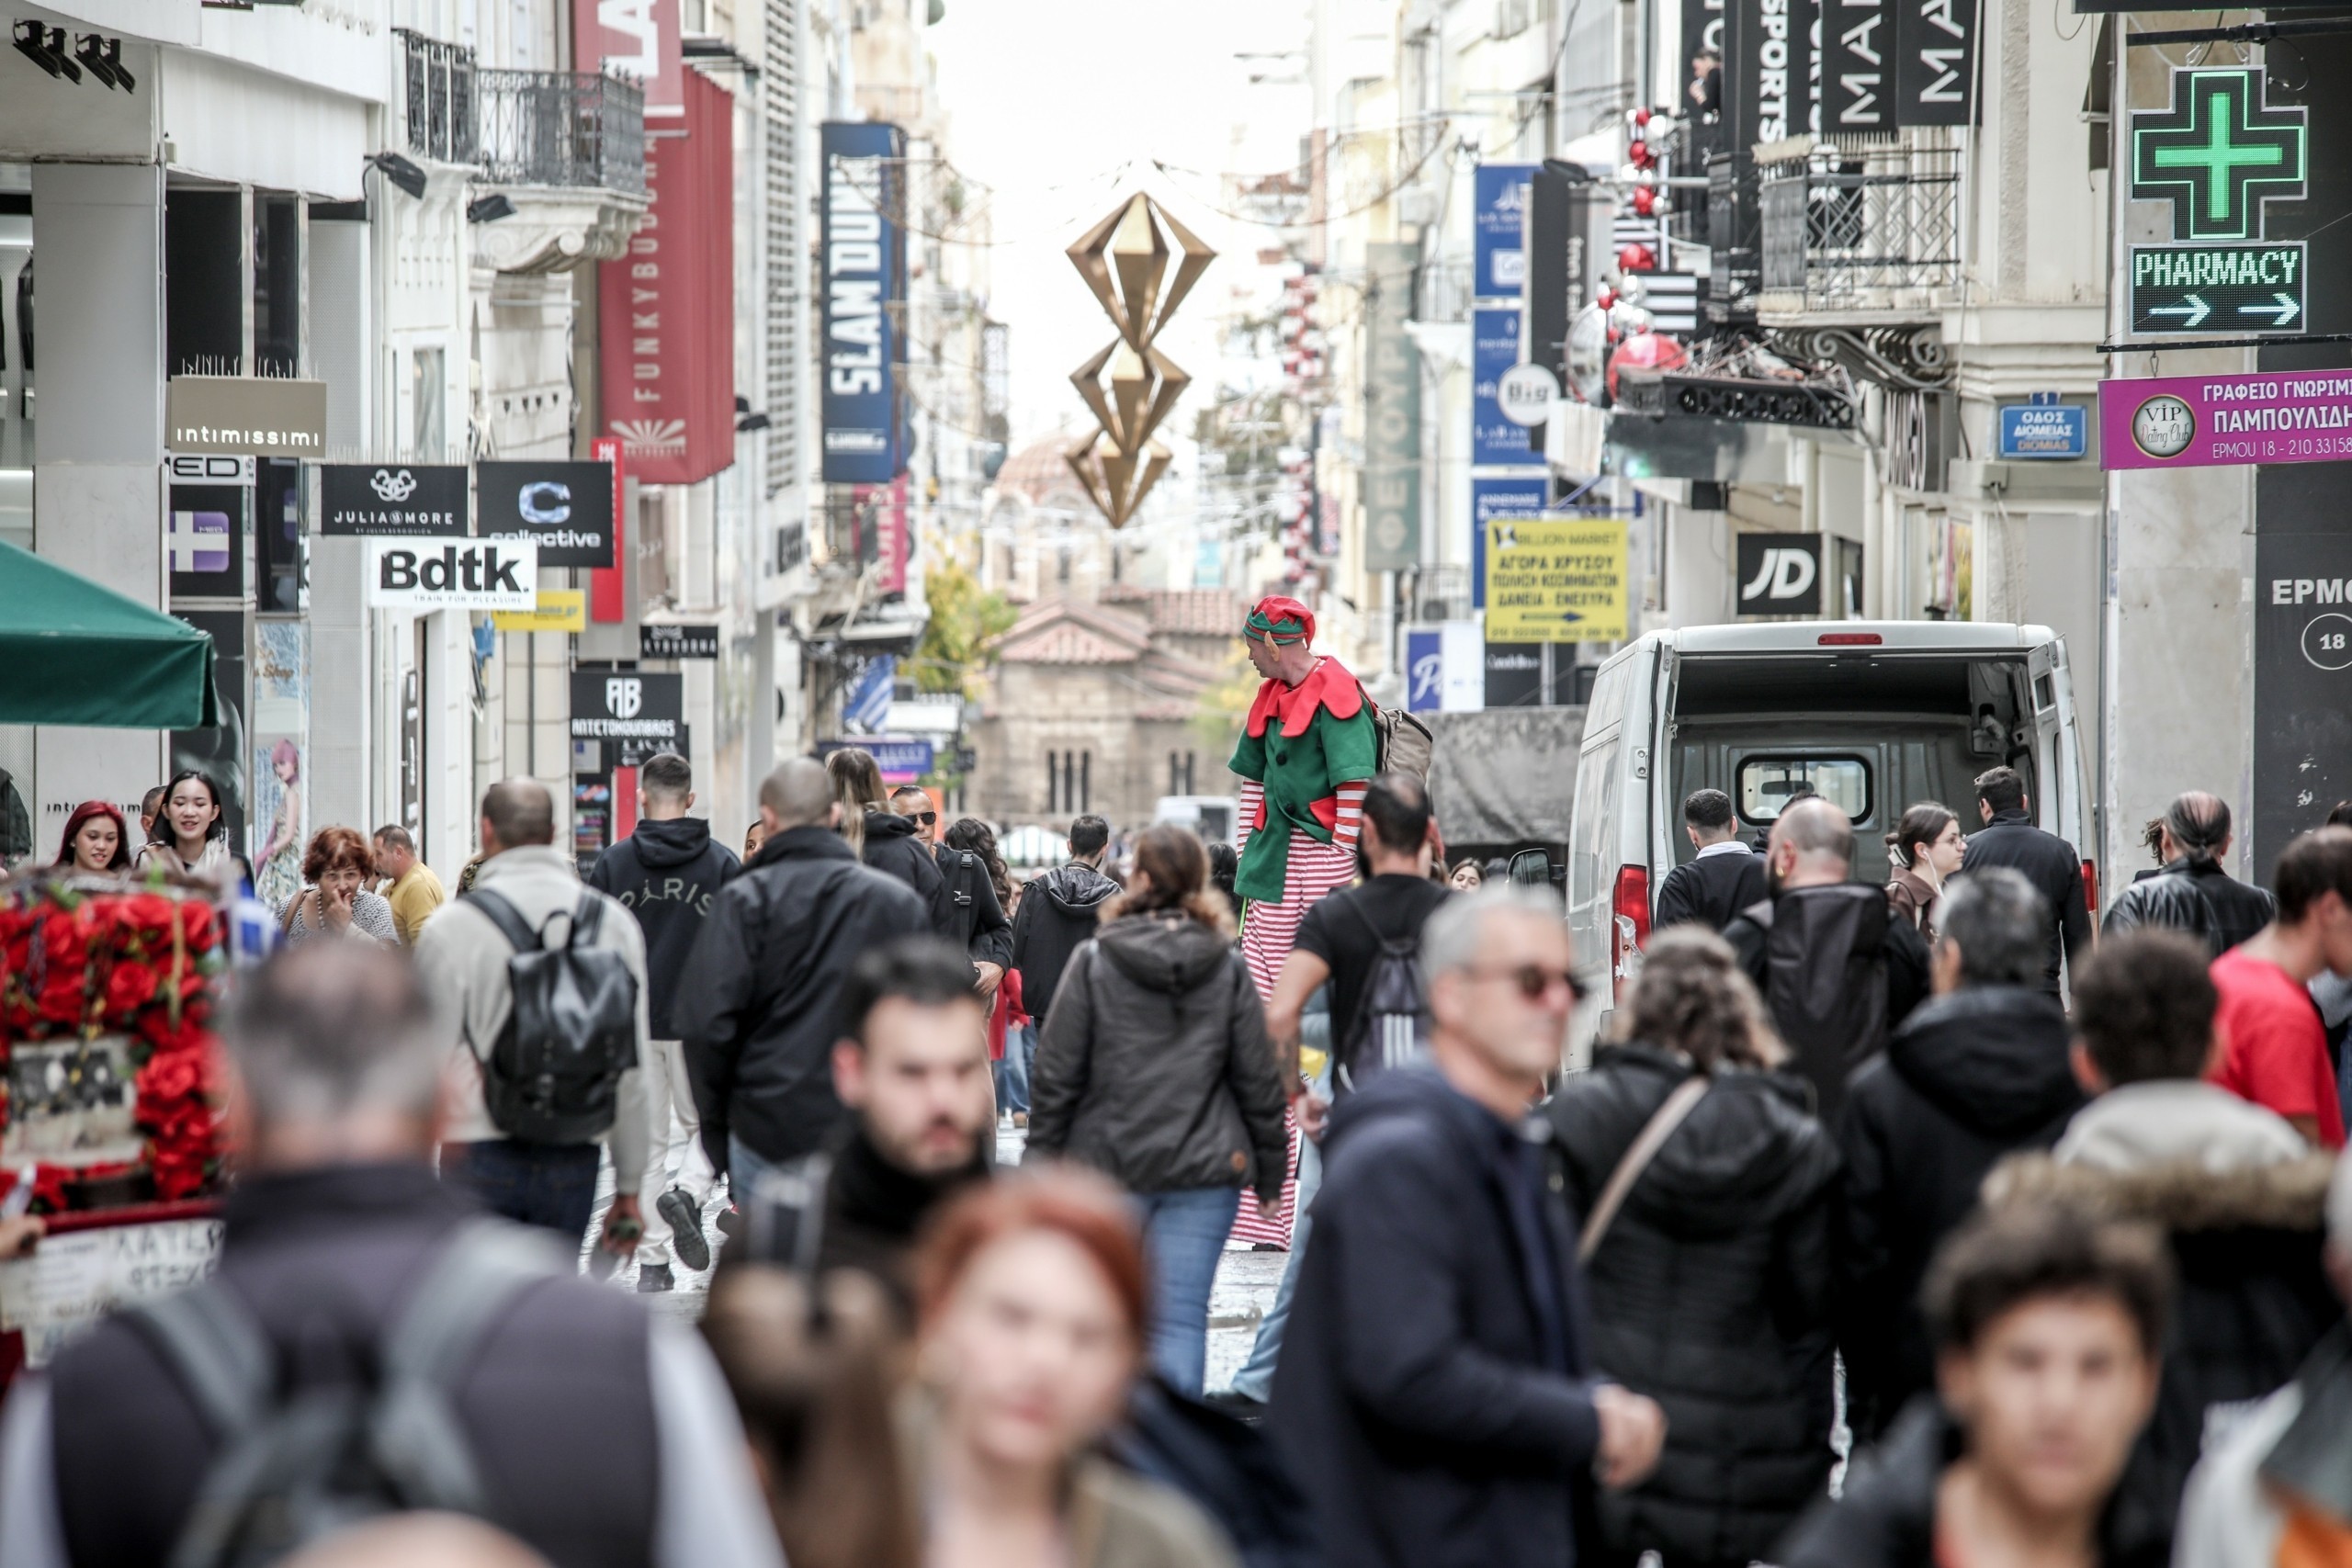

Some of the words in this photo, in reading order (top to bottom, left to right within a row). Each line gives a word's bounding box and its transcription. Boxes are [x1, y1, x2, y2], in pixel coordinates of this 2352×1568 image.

[1840, 0, 1881, 124] MA
[830, 152, 882, 275] DUNK
[2134, 250, 2299, 286] PHARMACY
[830, 280, 882, 395] SLAM
[2203, 381, 2278, 402] ΓΡΑΦΕΙΟ
[2021, 412, 2065, 423] ΟΔΟΣ
[2145, 404, 2182, 422] VIP
[176, 425, 319, 446] intimissimi
[2014, 423, 2073, 437] ΔΙΟΜΕΙΑΣ
[2142, 423, 2167, 448] Dating
[2170, 423, 2191, 442] Club
[2018, 439, 2070, 451] DIOMIAS
[2262, 440, 2276, 457] 18
[2289, 438, 2312, 455] 210
[164, 457, 240, 478] ED
[334, 511, 388, 524] JULIA
[405, 512, 454, 525] MORE
[1499, 556, 1549, 570] ΑΓΟΡΑ
[1742, 548, 1816, 601] JD
[473, 596, 523, 604] PLEASURE
[2319, 633, 2346, 649] 18
